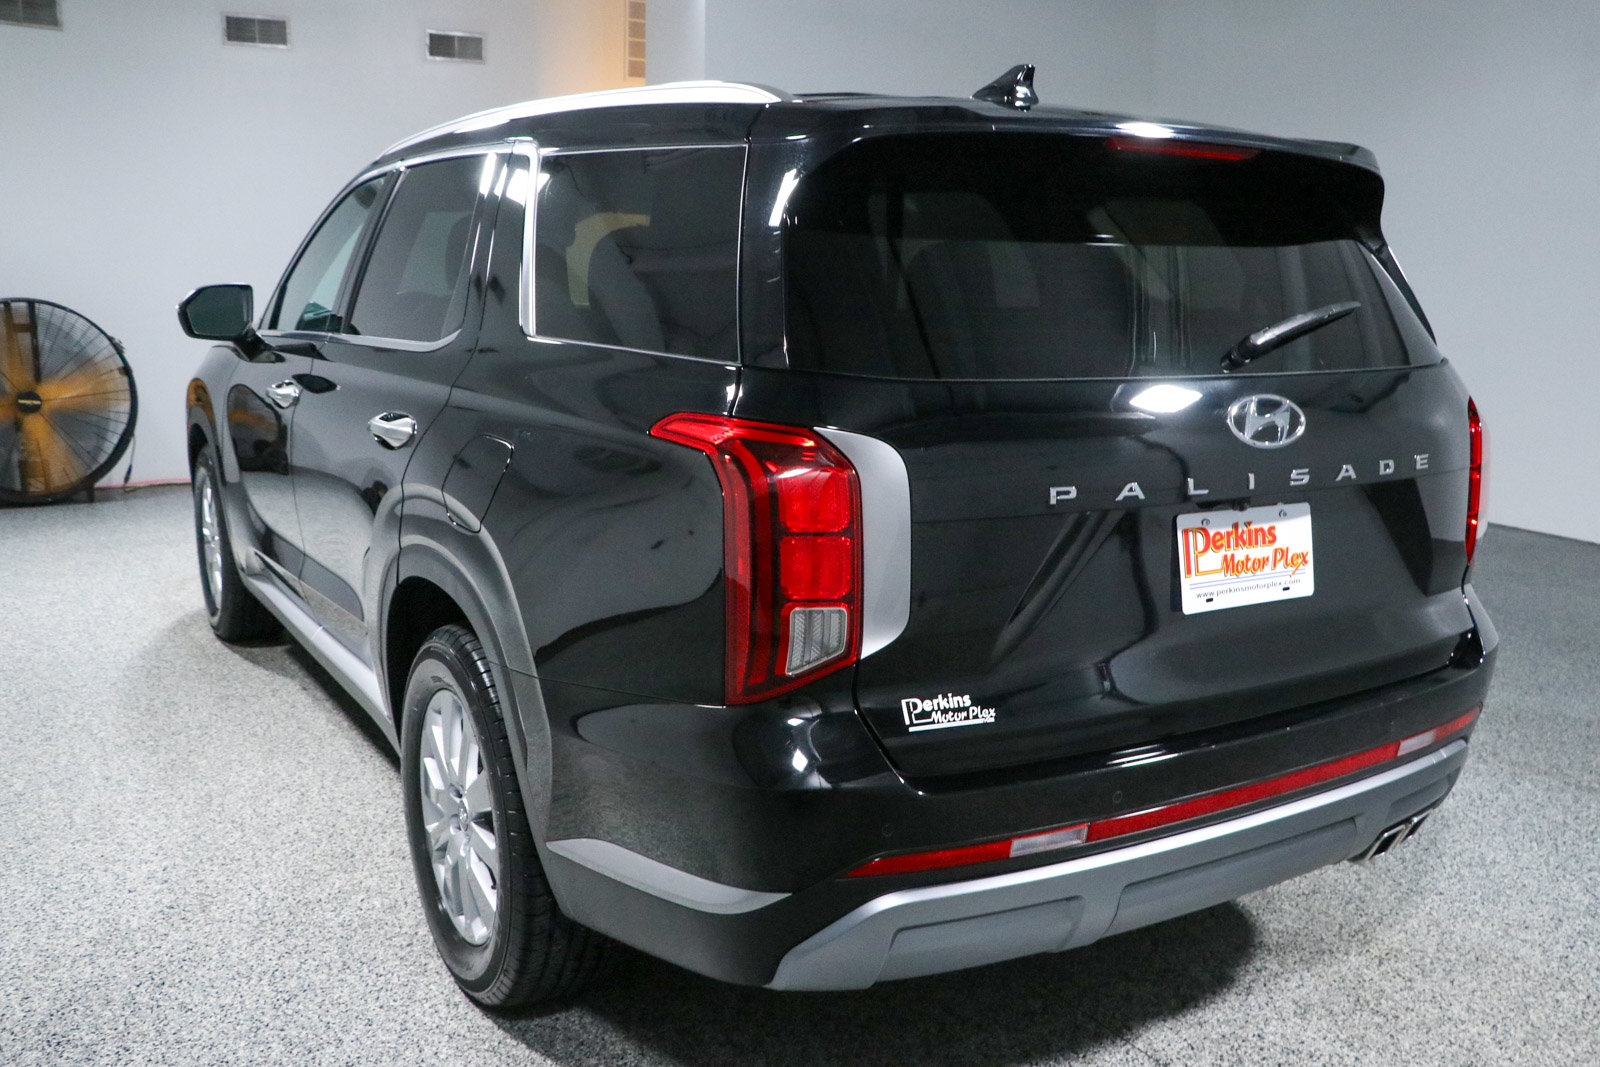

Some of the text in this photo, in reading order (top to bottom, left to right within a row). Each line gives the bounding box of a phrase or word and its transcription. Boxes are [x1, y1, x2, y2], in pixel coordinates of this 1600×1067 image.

[1049, 453, 1430, 505] PALISADE
[1182, 521, 1277, 578] Perkins
[1221, 546, 1309, 577] Motor Plex
[1196, 579, 1301, 600] www.perkinsmotorplex.com
[901, 693, 972, 726] Perkins
[931, 705, 996, 724] Motor Plex
